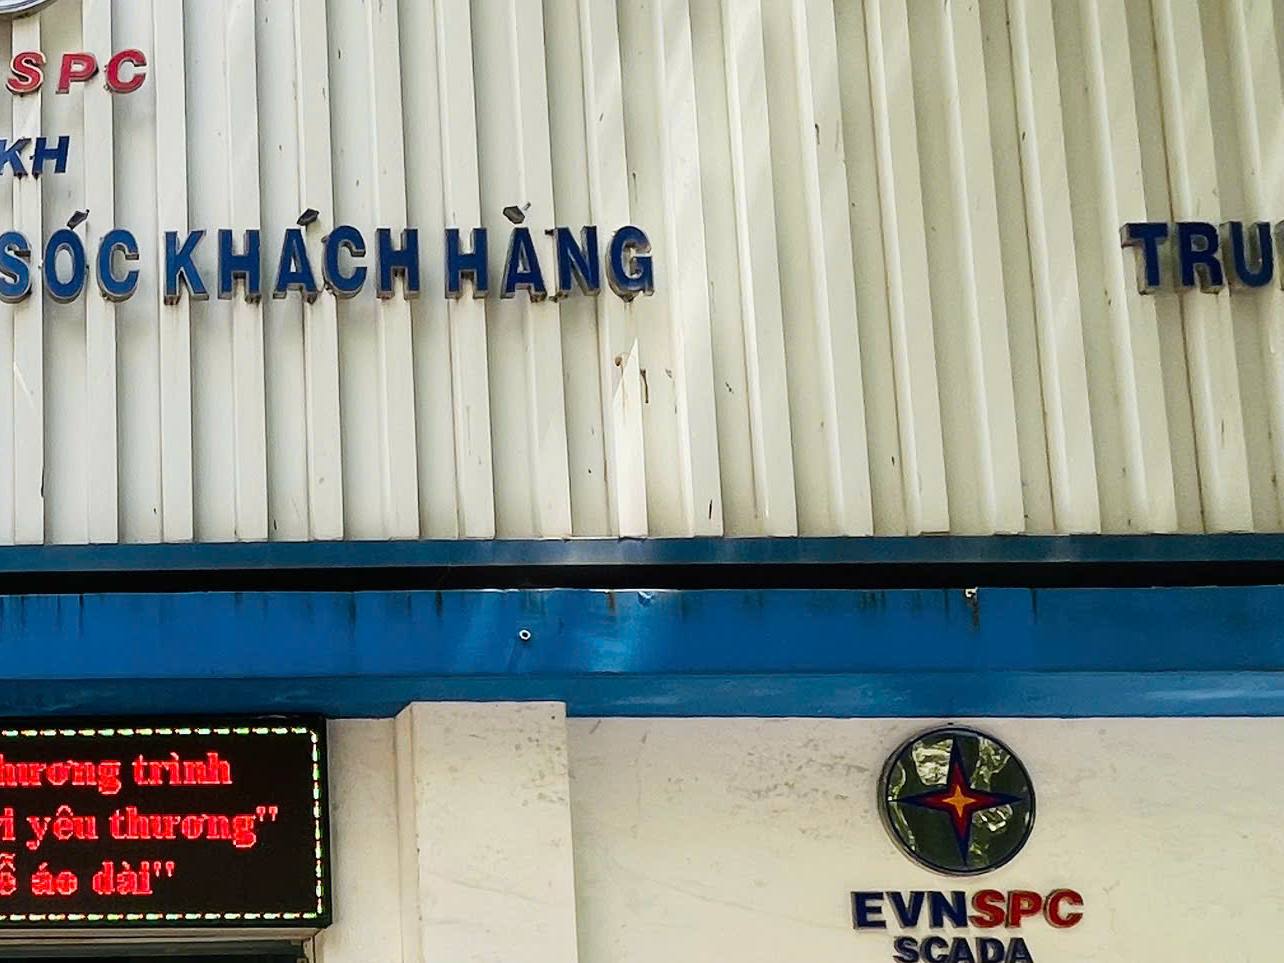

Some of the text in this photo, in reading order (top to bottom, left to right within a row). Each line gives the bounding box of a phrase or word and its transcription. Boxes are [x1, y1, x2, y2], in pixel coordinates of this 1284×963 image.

[164, 208, 419, 305] KHÁCH
[446, 202, 655, 304] HÀNG
[1119, 221, 1284, 295] TRU
[132, 751, 233, 785] trình
[26, 805, 98, 850] yêu
[109, 805, 278, 848] thương"
[32, 862, 78, 896] áo
[92, 861, 175, 896] dài"
[850, 889, 1084, 929] EVNSPC
